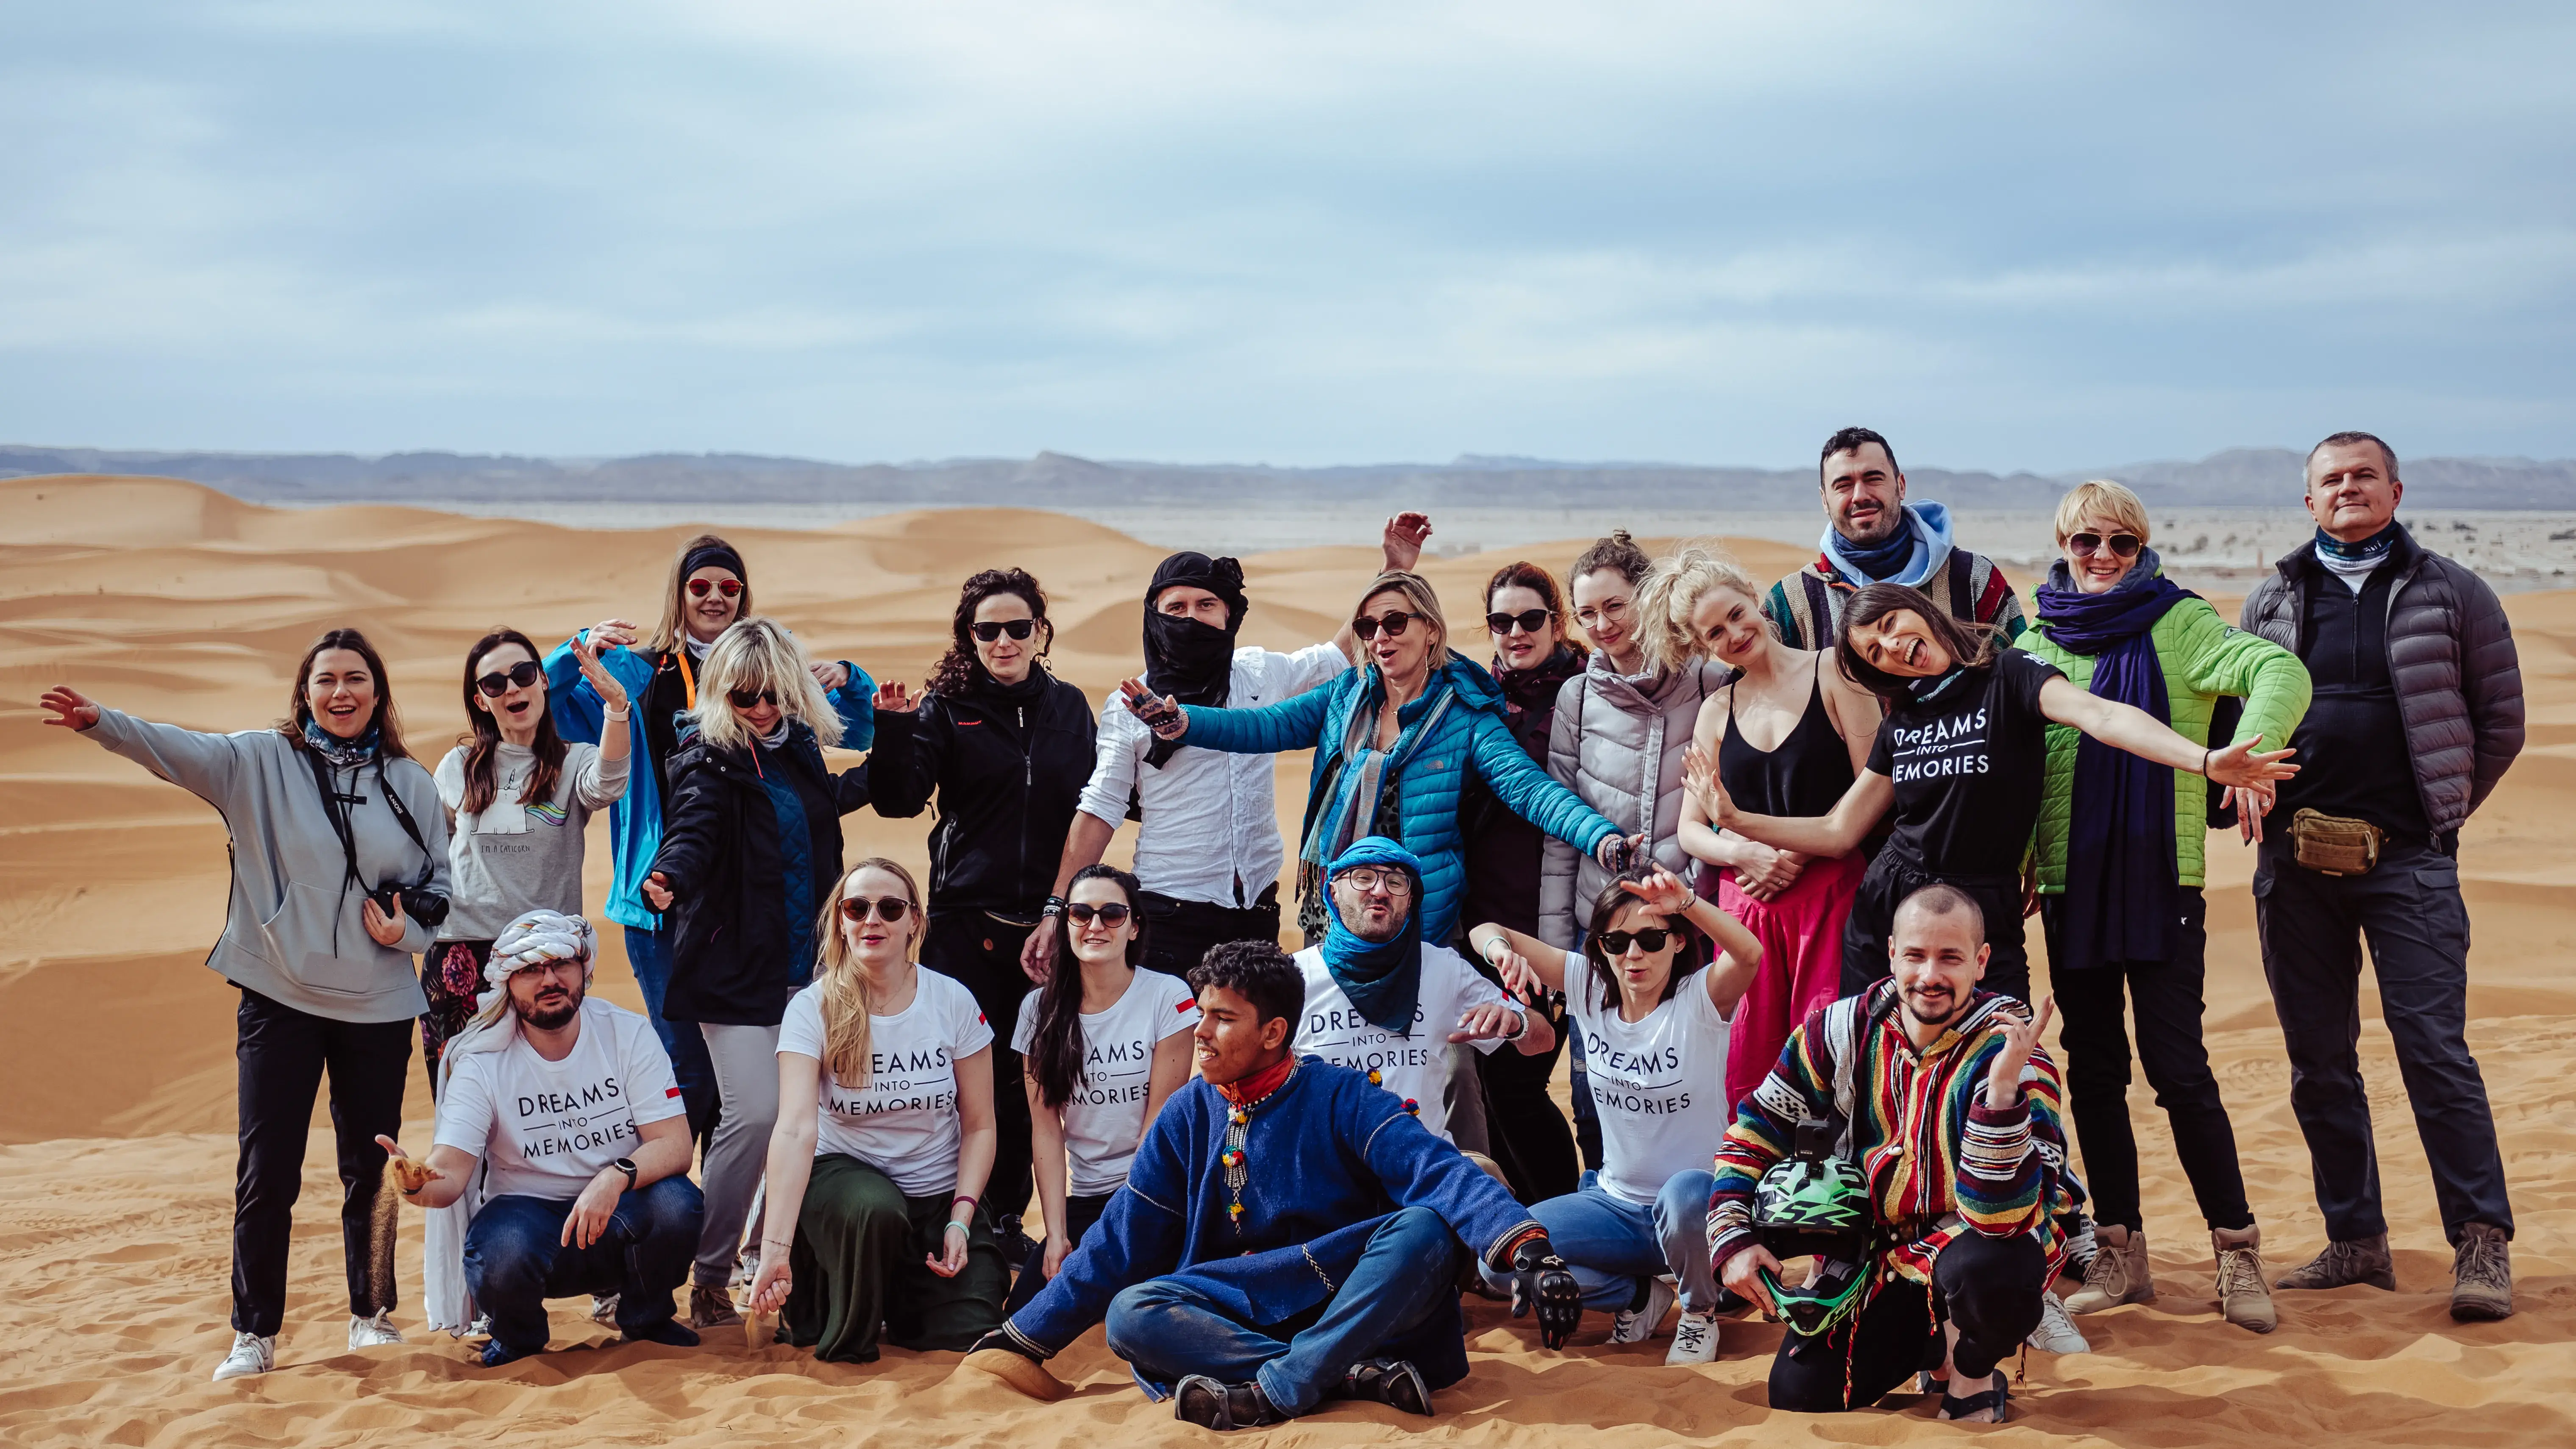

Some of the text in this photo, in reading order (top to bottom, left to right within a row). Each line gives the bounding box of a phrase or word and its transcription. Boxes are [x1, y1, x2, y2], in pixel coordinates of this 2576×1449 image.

[1894, 708, 1986, 747] DREAMS
[1917, 745, 1949, 756] INTO
[1892, 754, 1989, 784] EMORIES
[388, 794, 403, 814] SONY
[481, 844, 530, 853] I'M A CATICORN
[1311, 1003, 1424, 1034] DRES
[1352, 1033, 1386, 1047] INTO
[1331, 1049, 1428, 1071] EMORIES
[1588, 1032, 1678, 1075] DREAMS
[875, 1080, 910, 1092] INTO
[1064, 1082, 1149, 1107] MORIES
[1611, 1076, 1641, 1091] INTO
[518, 1078, 619, 1117] DREAMS
[829, 1090, 953, 1115] MEMORIES
[1590, 1085, 1691, 1114] EMORIES
[558, 1117, 588, 1130] INTO
[524, 1118, 636, 1159] MEMORIES
